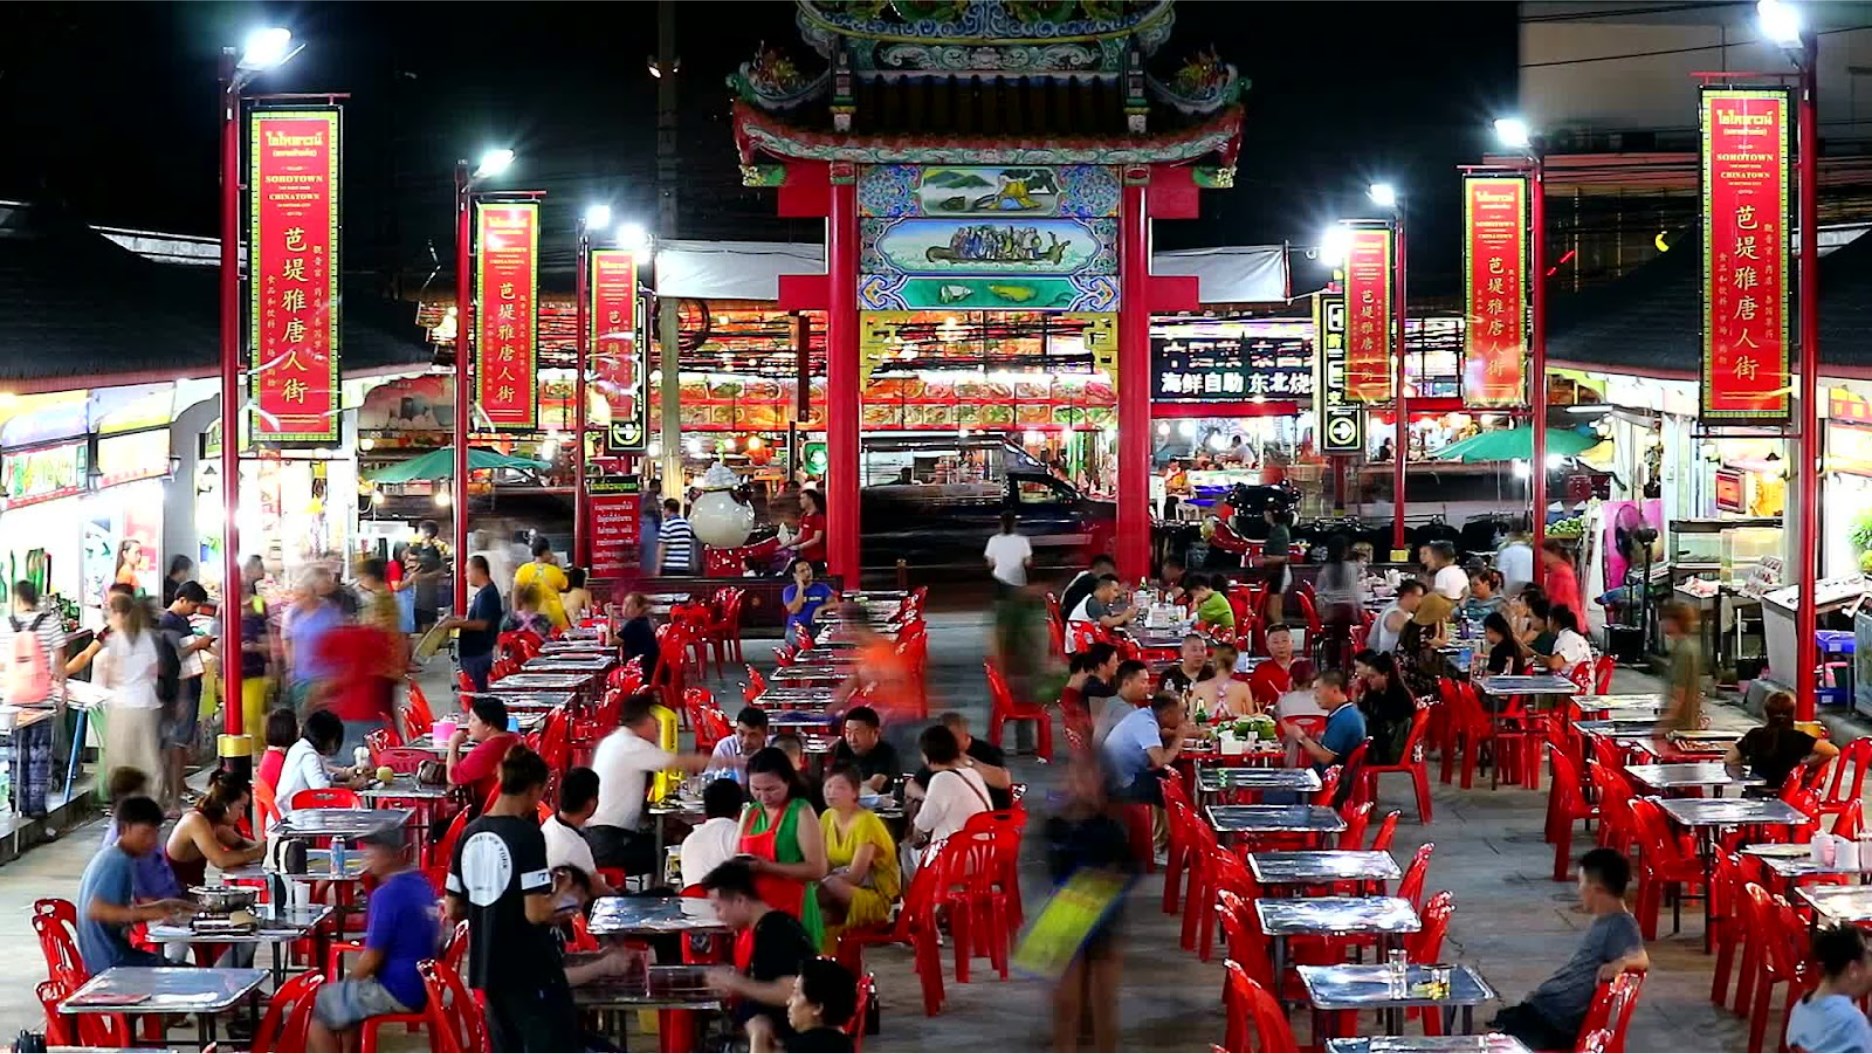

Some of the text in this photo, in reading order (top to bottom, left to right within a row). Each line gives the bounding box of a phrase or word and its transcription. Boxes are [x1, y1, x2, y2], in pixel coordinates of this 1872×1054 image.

[265, 175, 323, 183] SOHOTOWN
[281, 227, 309, 404] 芭堤雅唐人街
[496, 282, 516, 403] 芭堤雅唐人街
[1486, 257, 1505, 377] 芭堤雅唐人街
[1733, 205, 1760, 381] 芭堤雅唐人街
[1161, 372, 1313, 394] 海鲜自助 东北烧
